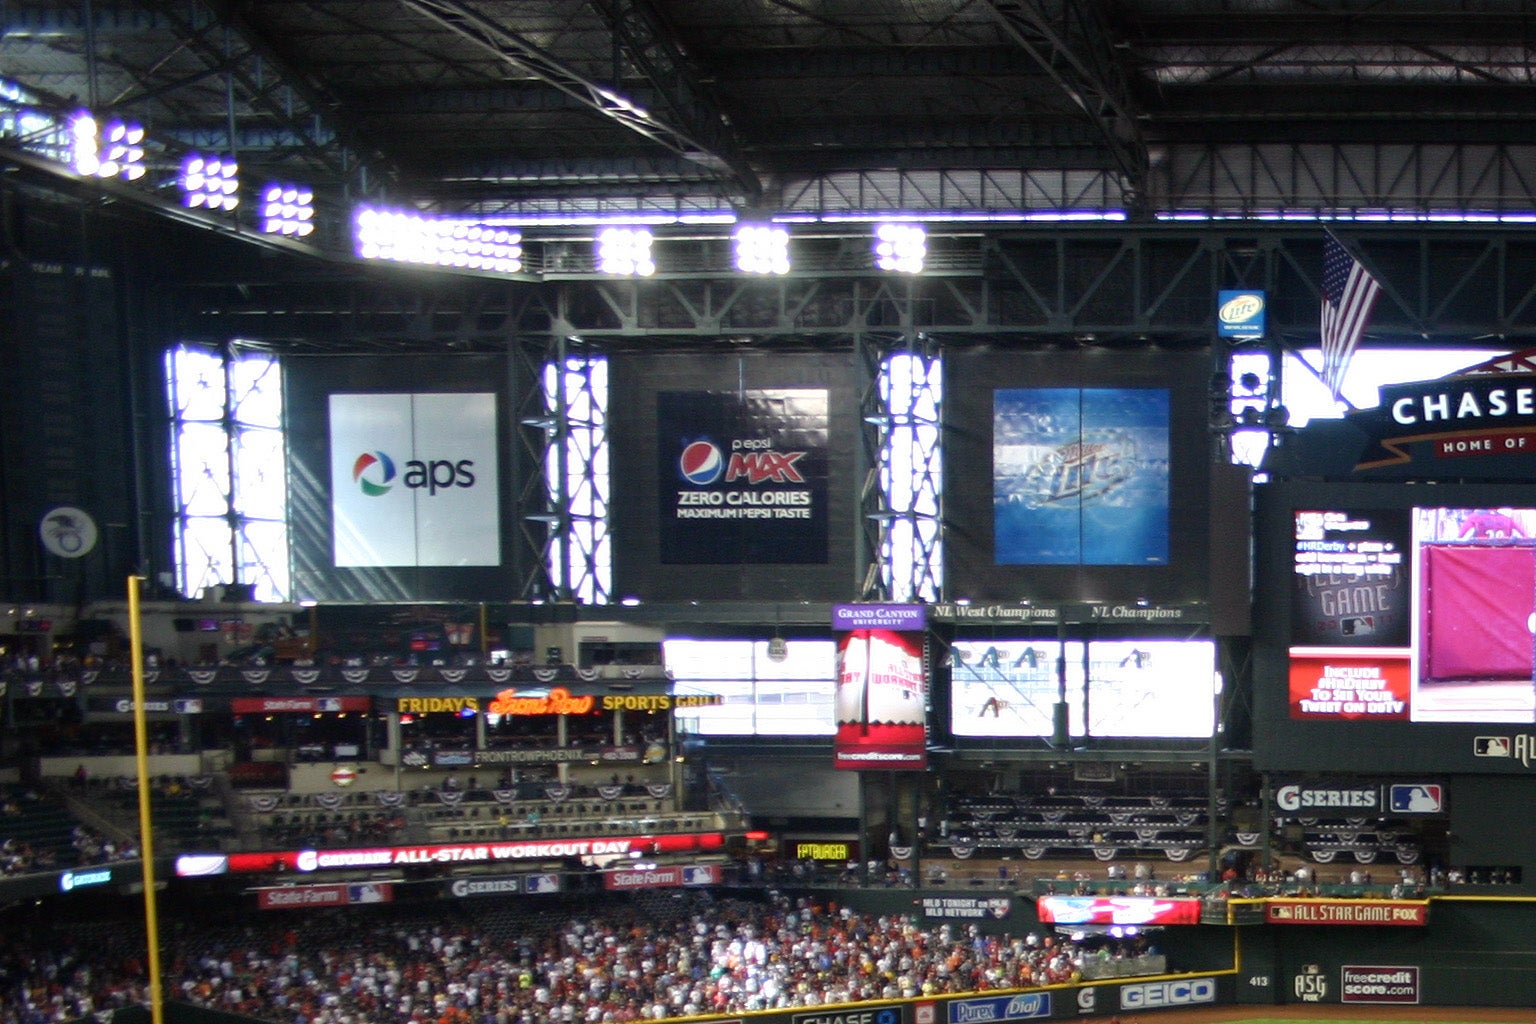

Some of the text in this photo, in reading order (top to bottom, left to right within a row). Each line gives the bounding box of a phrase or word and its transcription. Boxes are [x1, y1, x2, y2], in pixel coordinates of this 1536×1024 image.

[1391, 387, 1535, 425] CHASE
[731, 437, 772, 451] pepsi
[1443, 438, 1493, 454] HOME
[1505, 436, 1527, 449] OF
[724, 451, 807, 484] MAX
[402, 458, 476, 496] aps
[677, 491, 811, 506] ZERO CALORIES
[676, 508, 811, 519] MAXIMUM PEPSI TASTE
[1321, 585, 1391, 617] GAME
[838, 607, 919, 619] GRAND CANYON
[934, 605, 1056, 620] NL West Champions
[1091, 606, 1182, 620] NL Champions
[398, 697, 479, 712] FRIDAY'S
[603, 695, 670, 710] SPORTS
[1276, 785, 1376, 811] G SERIES
[394, 846, 488, 864] ALL-STAR
[492, 843, 590, 860] WORKOUT
[592, 841, 631, 855] DAY
[468, 879, 517, 893] SERIES
[922, 898, 941, 908] MLB
[942, 898, 977, 909] TONIGHT
[925, 908, 984, 918] MLB NETWORK
[1294, 904, 1418, 921] ALL STAR GAME FOX
[1249, 976, 1268, 987] 413
[1344, 971, 1411, 984] freecredit
[1077, 987, 1095, 1008] G
[1122, 980, 1215, 1007] GEICO
[1344, 984, 1414, 996] score.com
[957, 996, 1040, 1023] Purex Dial
